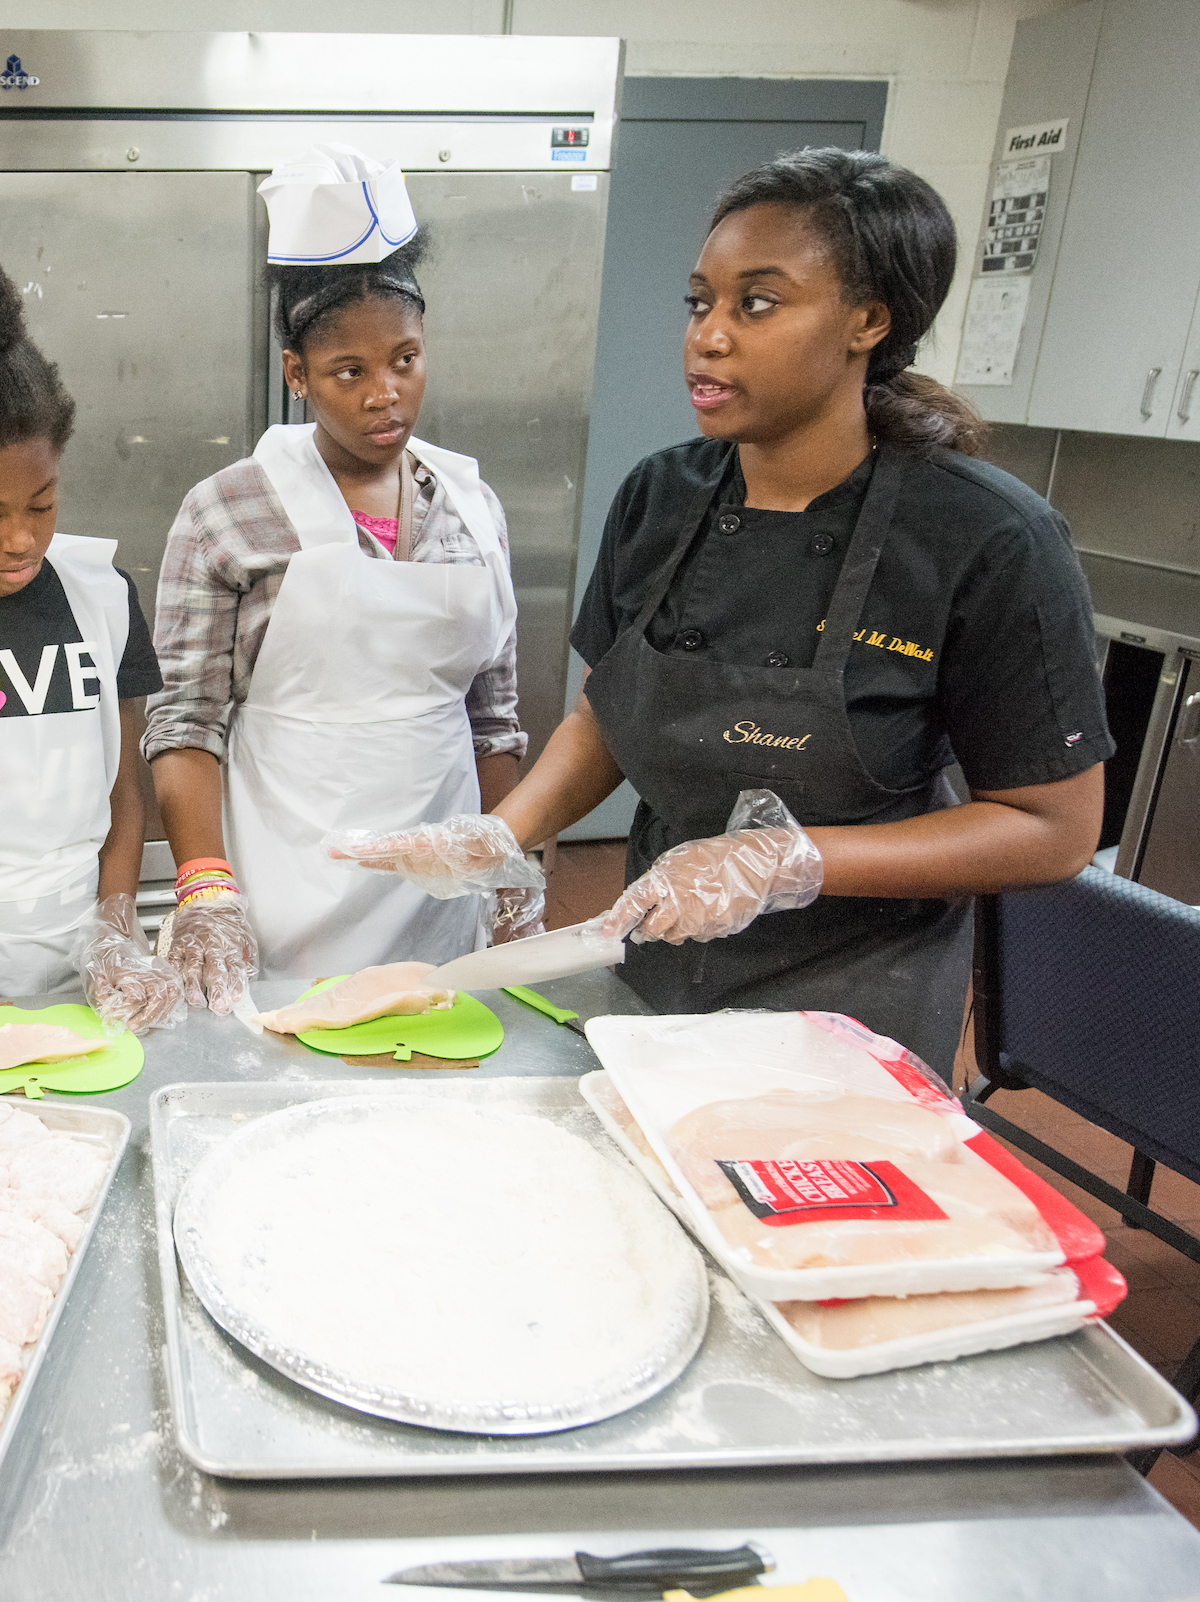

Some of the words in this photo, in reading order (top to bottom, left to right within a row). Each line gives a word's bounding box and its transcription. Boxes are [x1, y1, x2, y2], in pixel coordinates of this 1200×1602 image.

[1009, 134, 1036, 151] First
[1037, 128, 1062, 147] Aid
[554, 150, 585, 161] Freezer
[865, 631, 887, 649] M.
[886, 636, 934, 662] DeWalt
[723, 720, 812, 751] Shanel
[775, 1160, 828, 1203] CHICKE
